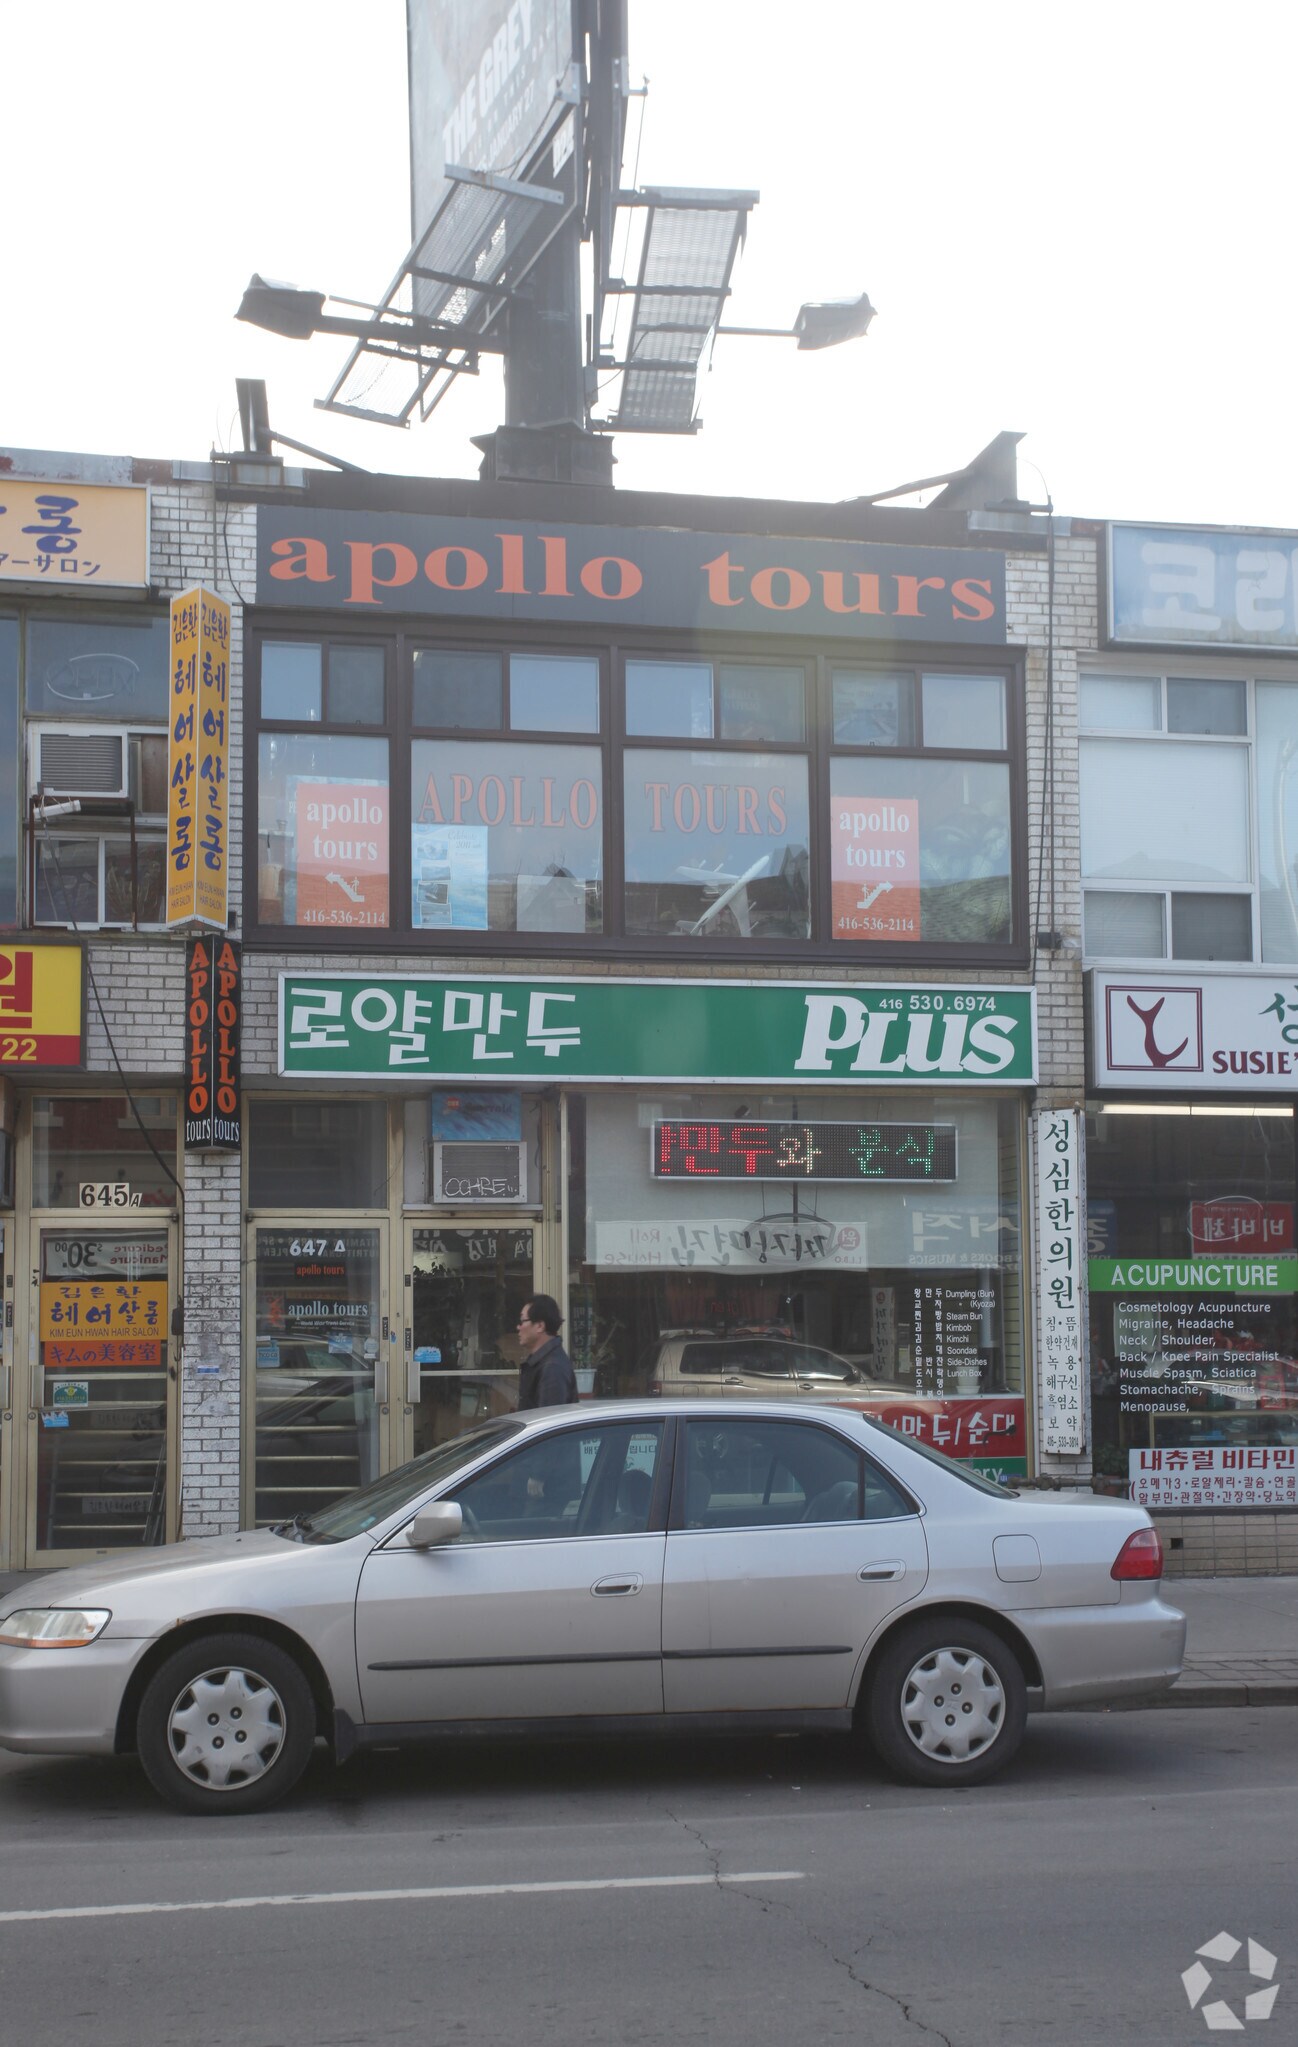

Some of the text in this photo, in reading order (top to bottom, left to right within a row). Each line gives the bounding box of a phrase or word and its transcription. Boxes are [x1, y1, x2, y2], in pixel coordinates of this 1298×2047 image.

[0, 495, 82, 554] 롱
[269, 534, 995, 621] apollo tours
[173, 603, 198, 645] 김은환
[202, 603, 228, 650] 김은환
[171, 653, 197, 871] 헤어살롱
[200, 651, 227, 871] 헤어살롱
[306, 797, 383, 830] apollo
[416, 771, 788, 836] APOLLO TOURS
[839, 807, 910, 838] apollo
[312, 834, 379, 861] tours
[845, 844, 907, 869] tours
[303, 909, 386, 925] 416-536-2114
[838, 917, 914, 931] 416-536-2114
[879, 995, 996, 1011] 416 530.6974
[189, 943, 209, 1114] APOLLO
[217, 943, 239, 1114] APOLLO
[289, 988, 581, 1065] 로얄만두
[186, 1117, 211, 1143] tours
[214, 1115, 240, 1143] tours
[848, 1129, 935, 1175] 분식
[1044, 1119, 1075, 1309] 성심한의원
[289, 1239, 327, 1257] 647
[296, 1264, 345, 1277] apollo tours
[1111, 1264, 1279, 1286] ACUPUNCTURE
[945, 1289, 976, 1299] Dumpling
[977, 1289, 995, 1299] (Bun)
[50, 1301, 159, 1326] 헤어살롱
[288, 1300, 329, 1320] apollo
[333, 1301, 368, 1316] tours
[946, 1312, 969, 1321] Steam
[970, 1312, 983, 1320] Bun
[1118, 1302, 1272, 1315] Cosmetology Acupuncture
[50, 1326, 159, 1338] KIM EUN HWAN HAIR SALON
[946, 1323, 973, 1332] Kimbob
[1118, 1318, 1235, 1331] Migraine, Headache
[946, 1335, 970, 1343] Kimchi
[1119, 1336, 1147, 1346] Neck
[1161, 1335, 1216, 1347] Shoulder,
[50, 1342, 157, 1363] キムの美容室
[947, 1346, 978, 1354] Soondae
[1119, 1352, 1147, 1362] Back
[1161, 1352, 1190, 1362] Knee
[1195, 1352, 1219, 1362] Pain
[1223, 1351, 1280, 1364] Specialist
[947, 1357, 988, 1366] Side-Dishes
[947, 1369, 968, 1378] Lunch
[969, 1369, 982, 1377] Box
[1119, 1367, 1257, 1380] Muscle Spasm, Sciatica
[1119, 1384, 1255, 1396] Stomachache, Sprains
[1120, 1402, 1191, 1413] Menopause,
[1140, 1449, 1295, 1471] 내츄럴 비타민
